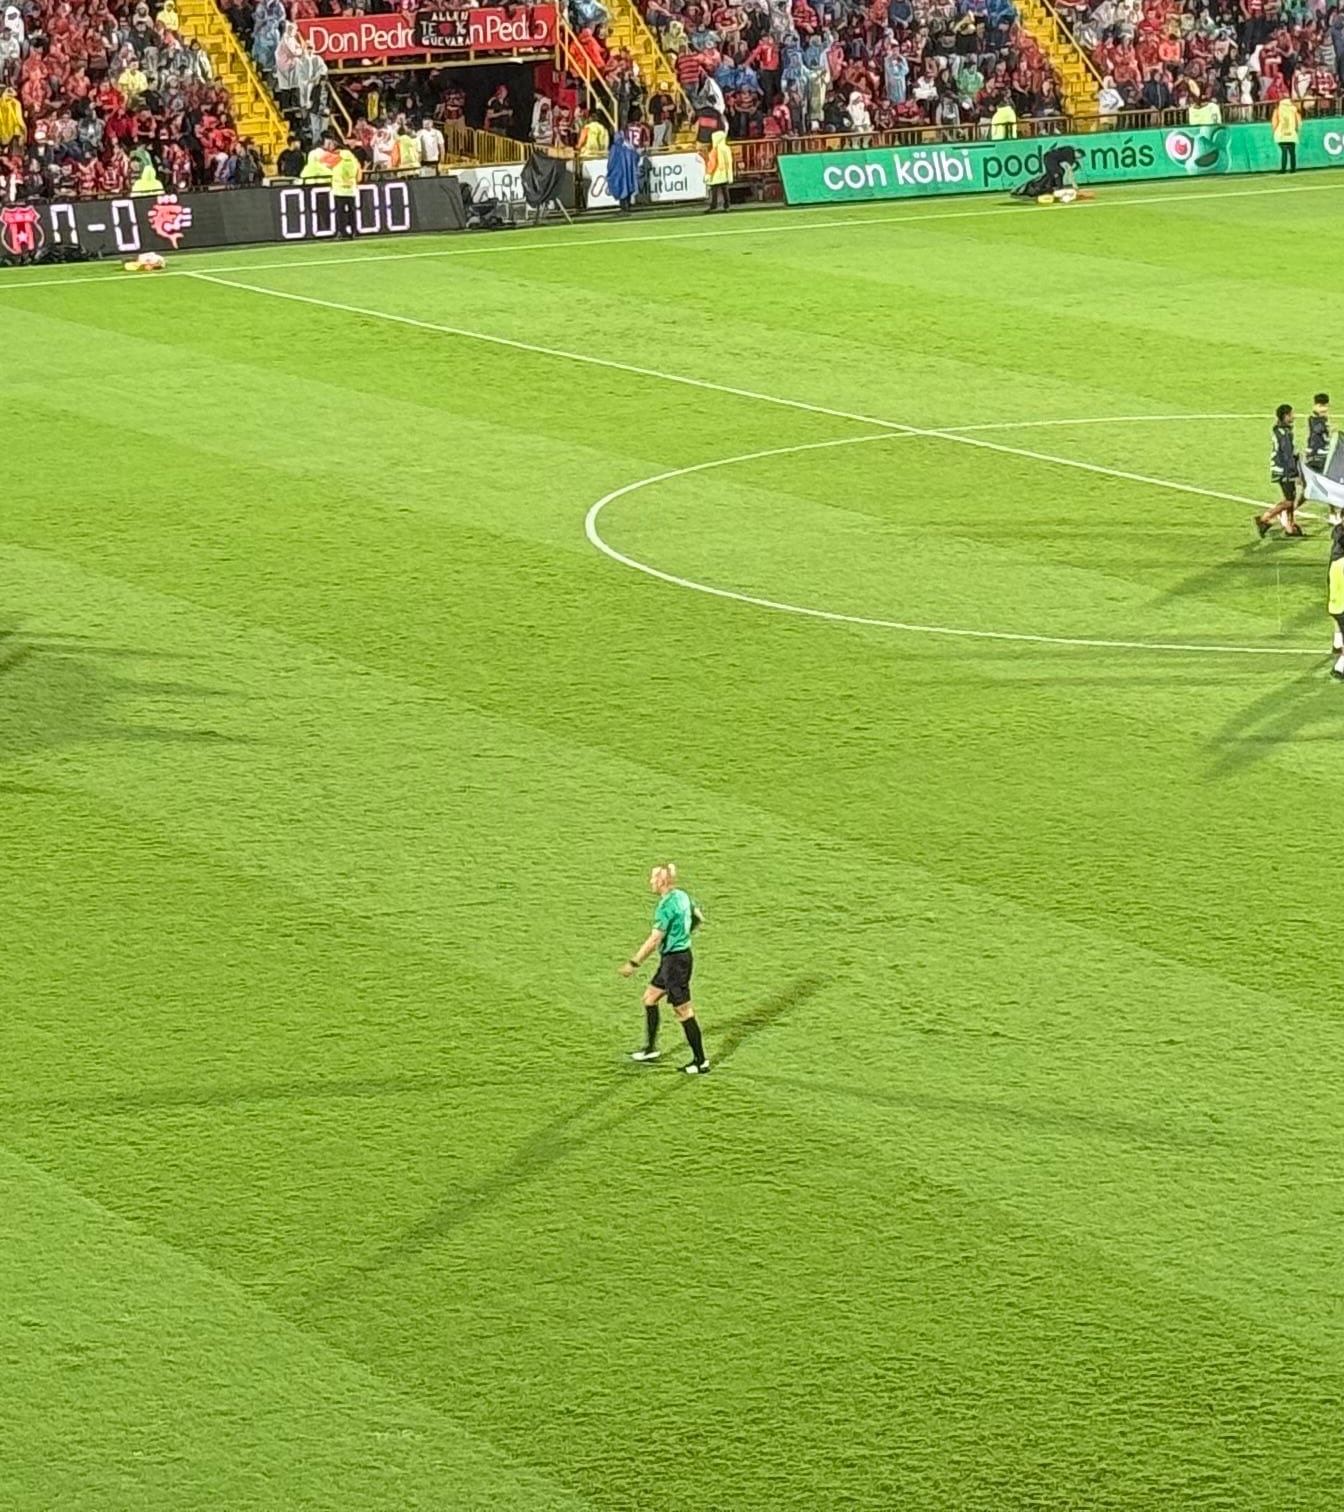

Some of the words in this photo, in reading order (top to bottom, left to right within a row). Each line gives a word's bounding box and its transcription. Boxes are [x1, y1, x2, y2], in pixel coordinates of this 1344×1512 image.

[309, 26, 359, 54] Don
[422, 35, 472, 47] GUEVARA
[646, 163, 683, 181] rupo
[823, 165, 889, 191] con
[893, 148, 973, 187] kölbi
[983, 143, 1086, 187] pods
[1091, 139, 1155, 170] más
[646, 176, 688, 195] utual
[112, 199, 141, 251] 0
